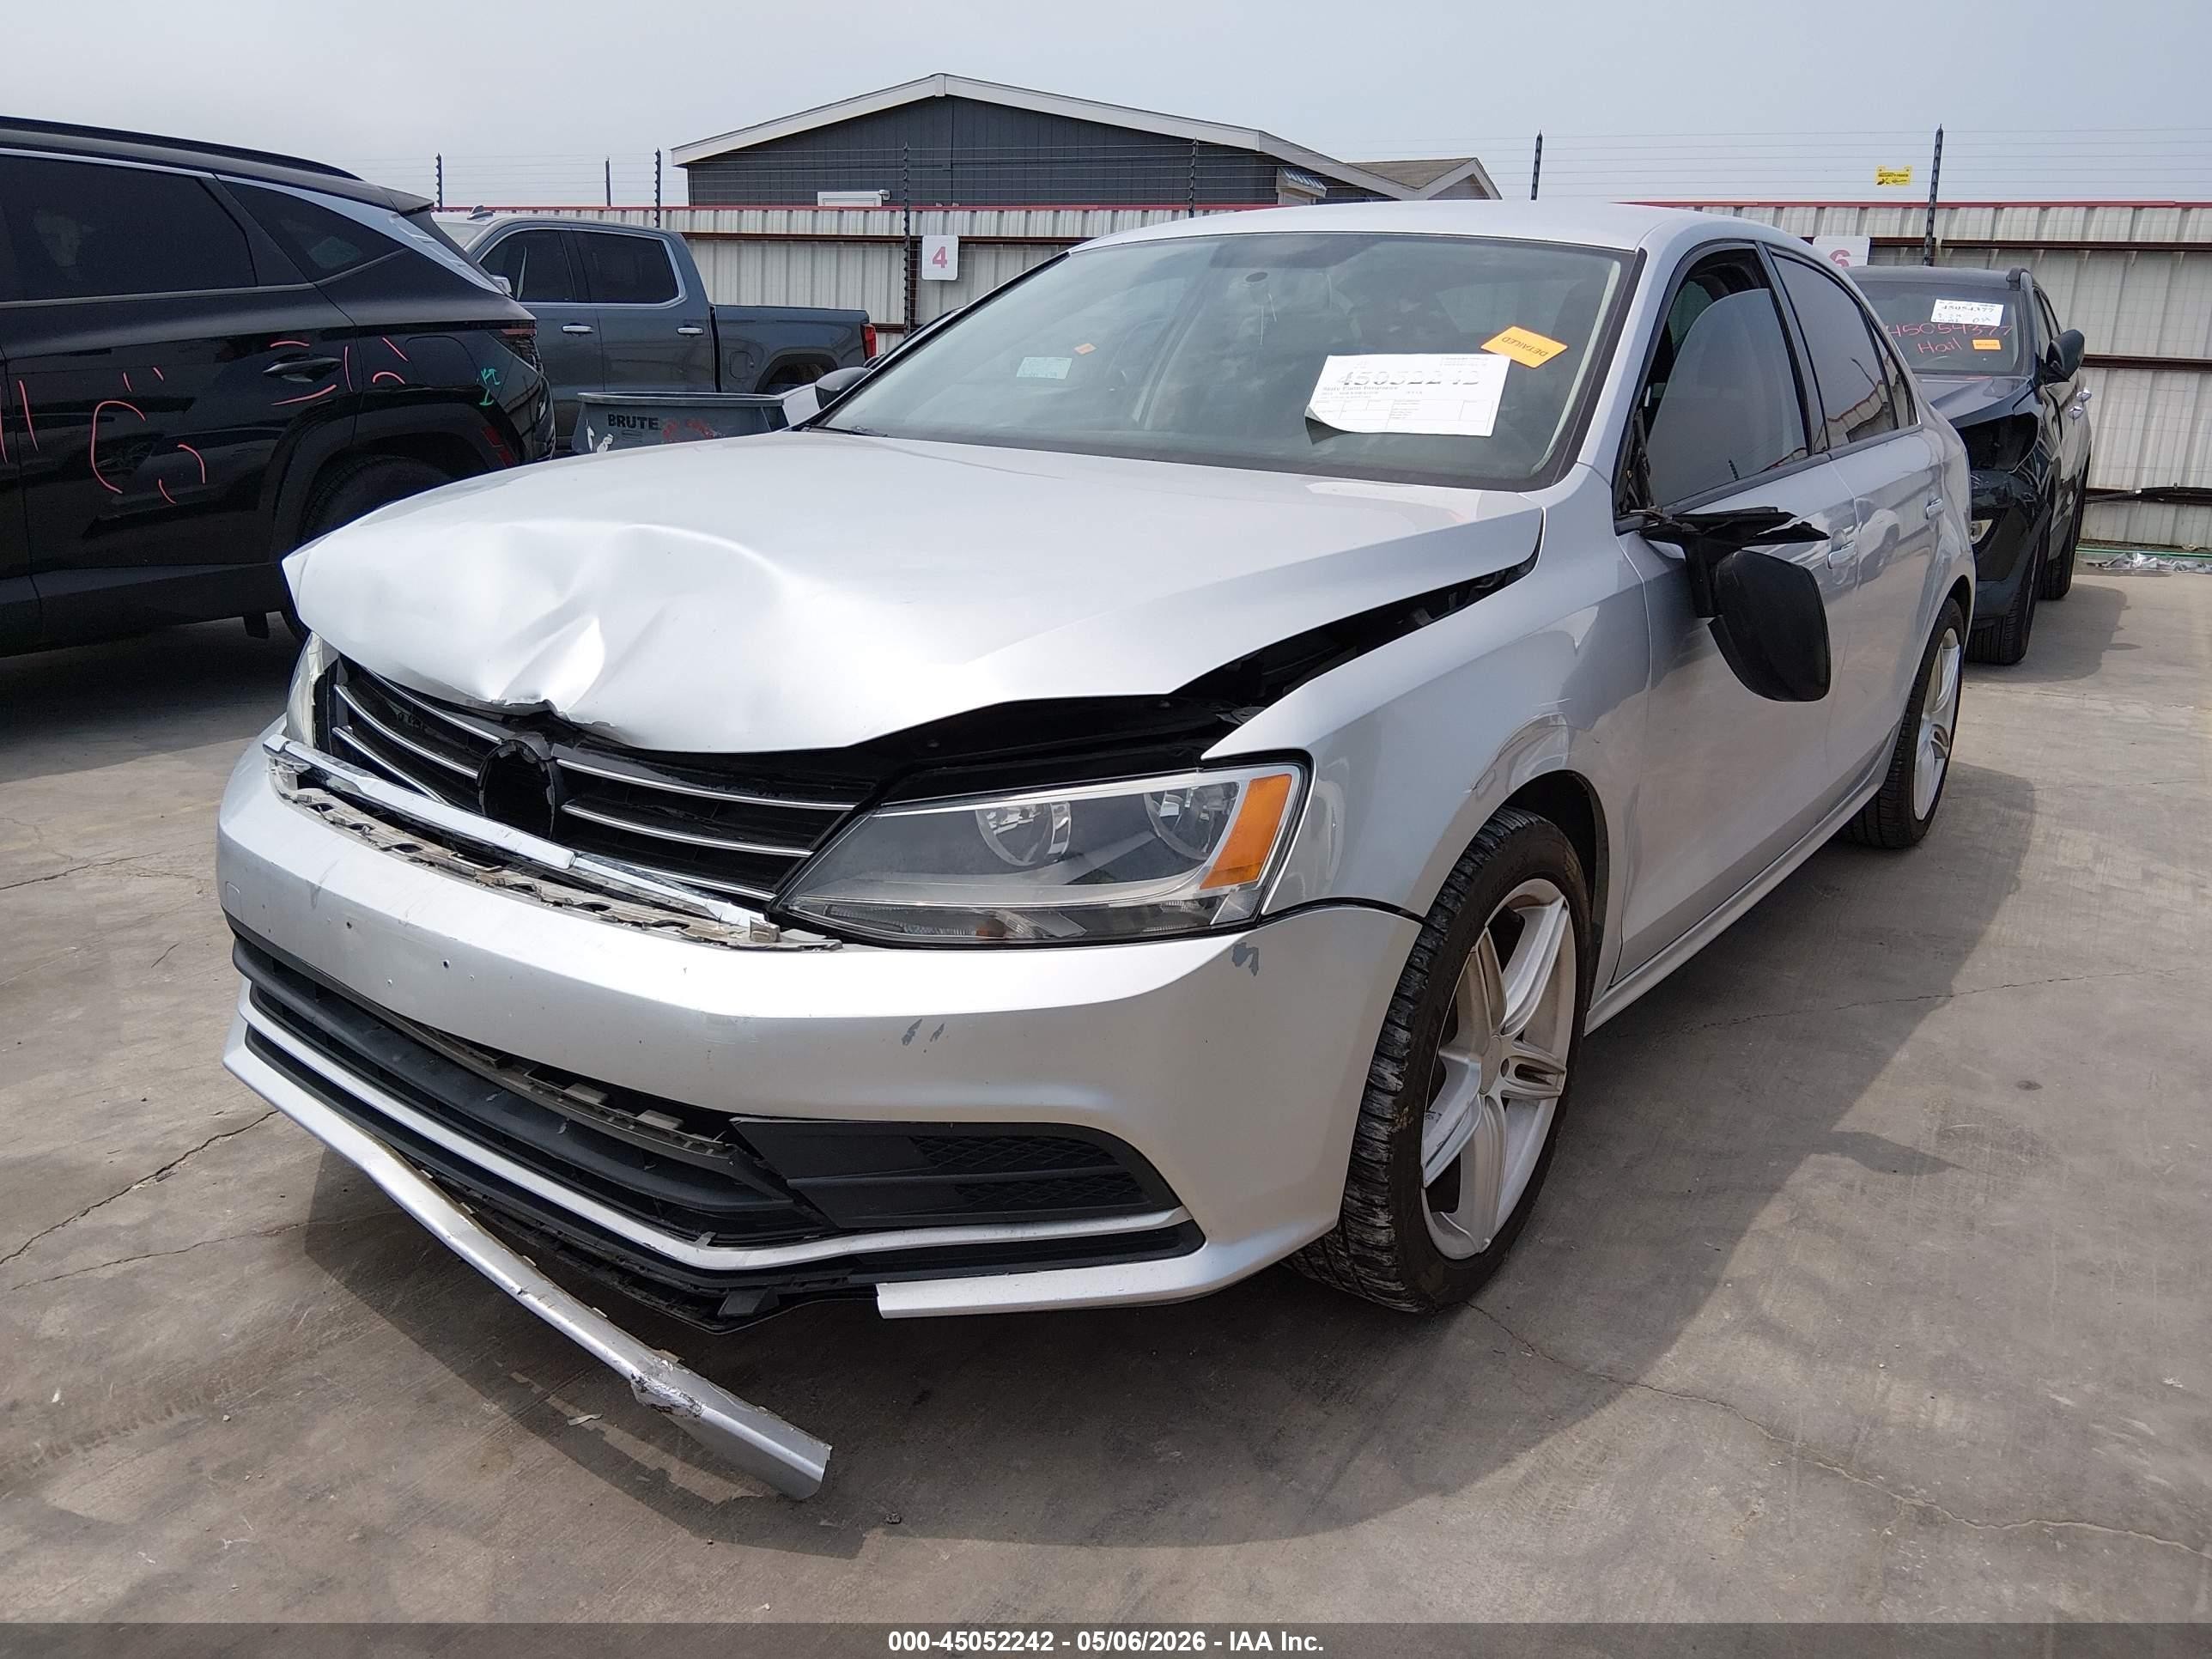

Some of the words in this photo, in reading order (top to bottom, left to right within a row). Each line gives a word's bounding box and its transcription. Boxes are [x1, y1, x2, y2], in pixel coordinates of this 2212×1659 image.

[933, 246, 947, 268] 4
[1830, 249, 1850, 267] 6
[1501, 337, 1549, 356] DETAILED
[1917, 337, 1963, 354] Hail
[608, 413, 659, 430] BRUTE
